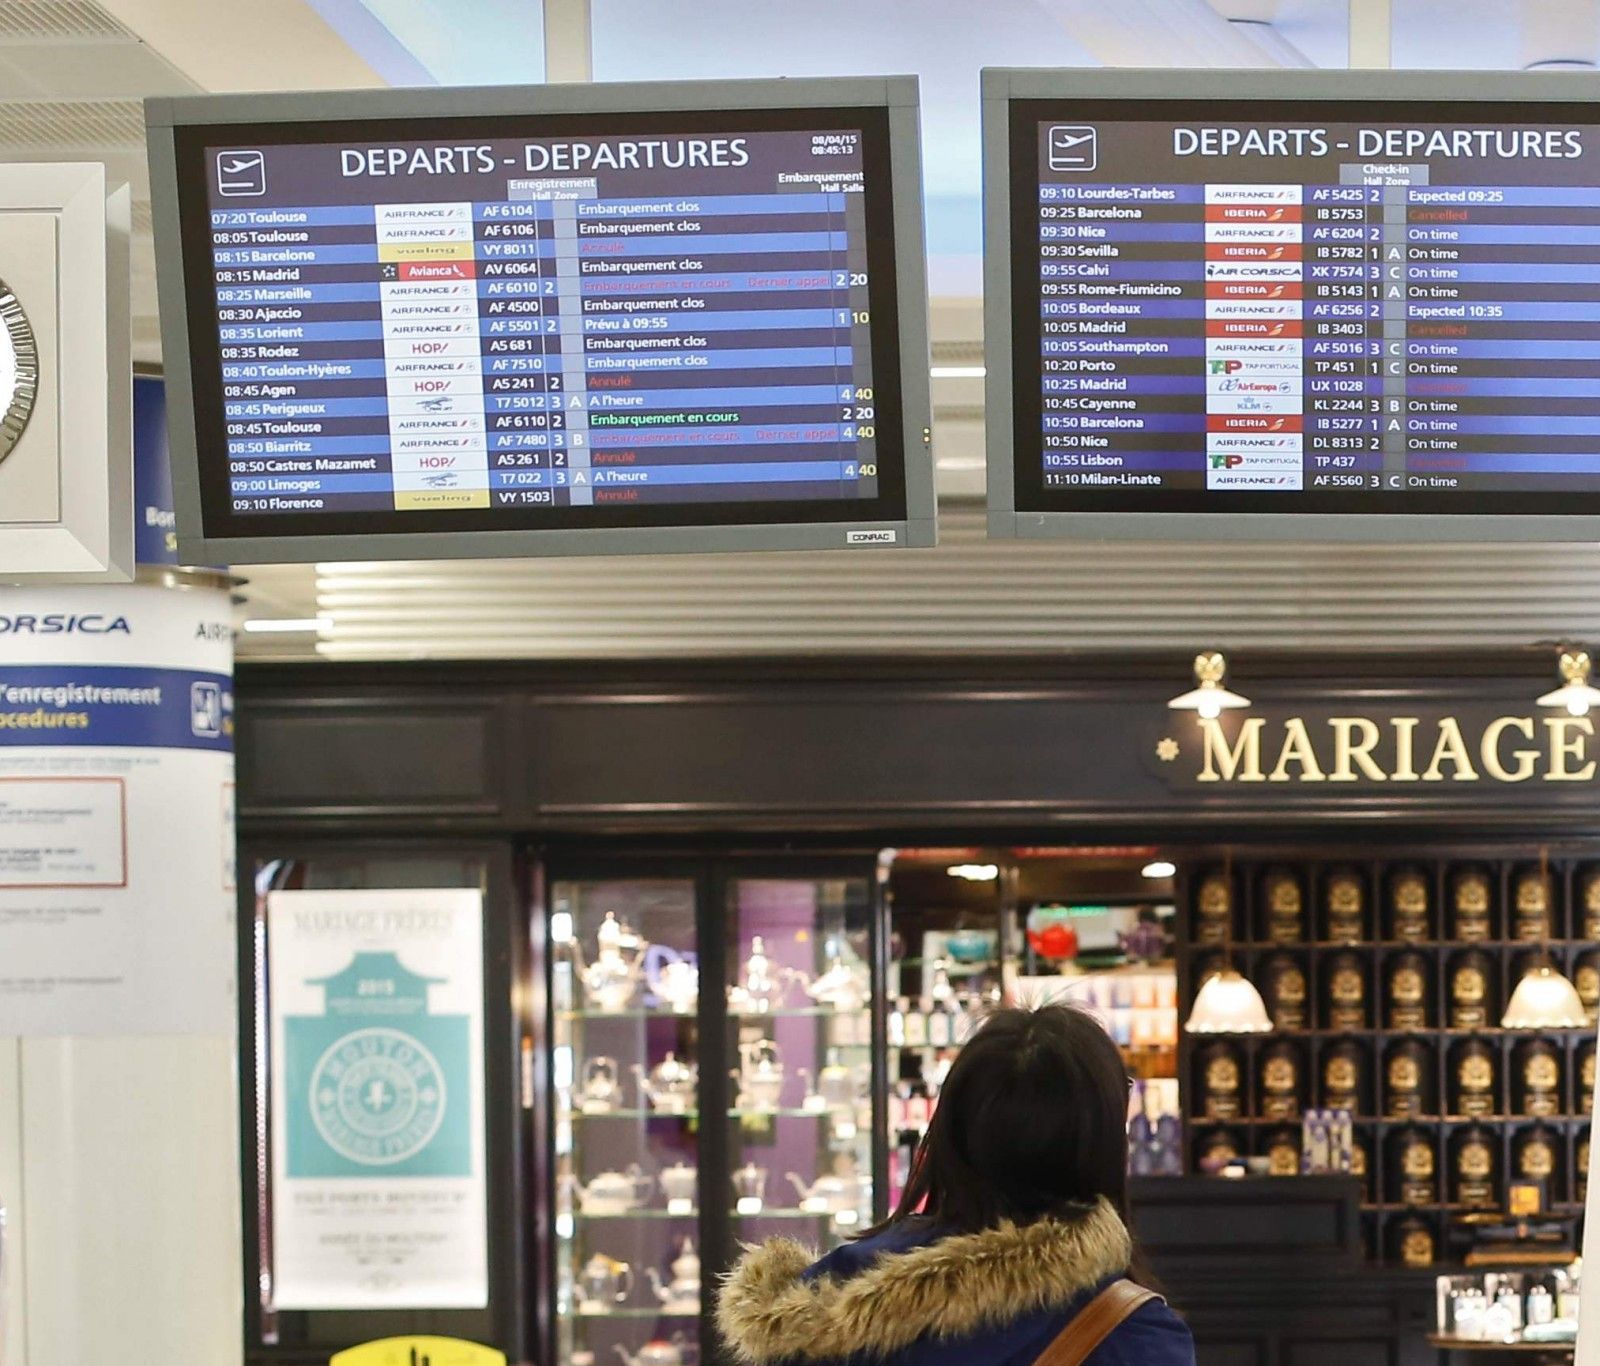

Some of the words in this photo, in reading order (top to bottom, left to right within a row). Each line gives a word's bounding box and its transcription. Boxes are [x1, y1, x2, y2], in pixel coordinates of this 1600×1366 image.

[812, 135, 857, 145] 08/04/15
[1174, 129, 1327, 156] DEPARTS
[1359, 129, 1582, 158] DEPARTURES
[812, 145, 853, 155] 08:45:13
[341, 146, 495, 176] DEPARTS
[525, 139, 749, 171] DEPARTURES
[1363, 164, 1409, 175] Check-in
[510, 178, 596, 192] Enregistrement
[779, 172, 864, 184] Embarquement
[212, 213, 246, 224] 07:20
[250, 212, 307, 223] Toulouse
[484, 206, 501, 216] AF
[502, 205, 533, 216] 6104
[579, 203, 673, 215] Embarquement
[677, 202, 699, 212] clos
[1041, 207, 1076, 218] 09:25
[1078, 207, 1142, 218] Barcelona
[1318, 209, 1330, 219] IB
[1333, 209, 1363, 219] 5753
[1041, 246, 1076, 256] 09:30
[1078, 245, 1118, 257] Sevilla
[1318, 248, 1330, 258] IB
[1333, 247, 1363, 258] 5782
[1371, 248, 1378, 258] 1
[1389, 248, 1400, 259] A
[1409, 249, 1428, 258] On
[1431, 248, 1458, 259] time
[216, 271, 250, 281] 08:15
[253, 269, 300, 281] Madrid
[409, 265, 452, 276] Avianca
[485, 264, 502, 274] AV
[505, 263, 536, 274] 6064
[582, 261, 676, 273] Embarquement
[679, 259, 703, 270] clos
[1041, 265, 1076, 275] 09:55
[1079, 264, 1109, 276] Calvi
[221, 328, 254, 339] 08:35
[257, 327, 303, 338] Lorient
[586, 318, 620, 330] Prévu
[622, 319, 630, 329] à
[633, 318, 667, 329] 09:55
[1044, 342, 1078, 352] 10:05
[1080, 341, 1168, 355] Southampton
[1045, 398, 1078, 409] 10:45
[1080, 399, 1136, 412] Cayenne
[1315, 400, 1330, 410] KL
[1333, 400, 1363, 410] 2244
[231, 462, 265, 472] 08:50
[266, 460, 312, 471] Castres
[316, 458, 375, 470] Mazamet
[1046, 475, 1079, 485] 11:10
[1081, 474, 1161, 485] Milan-Linate
[1409, 477, 1427, 486] On
[1430, 476, 1458, 487] time
[1196, 715, 1597, 783] MARIAGE
